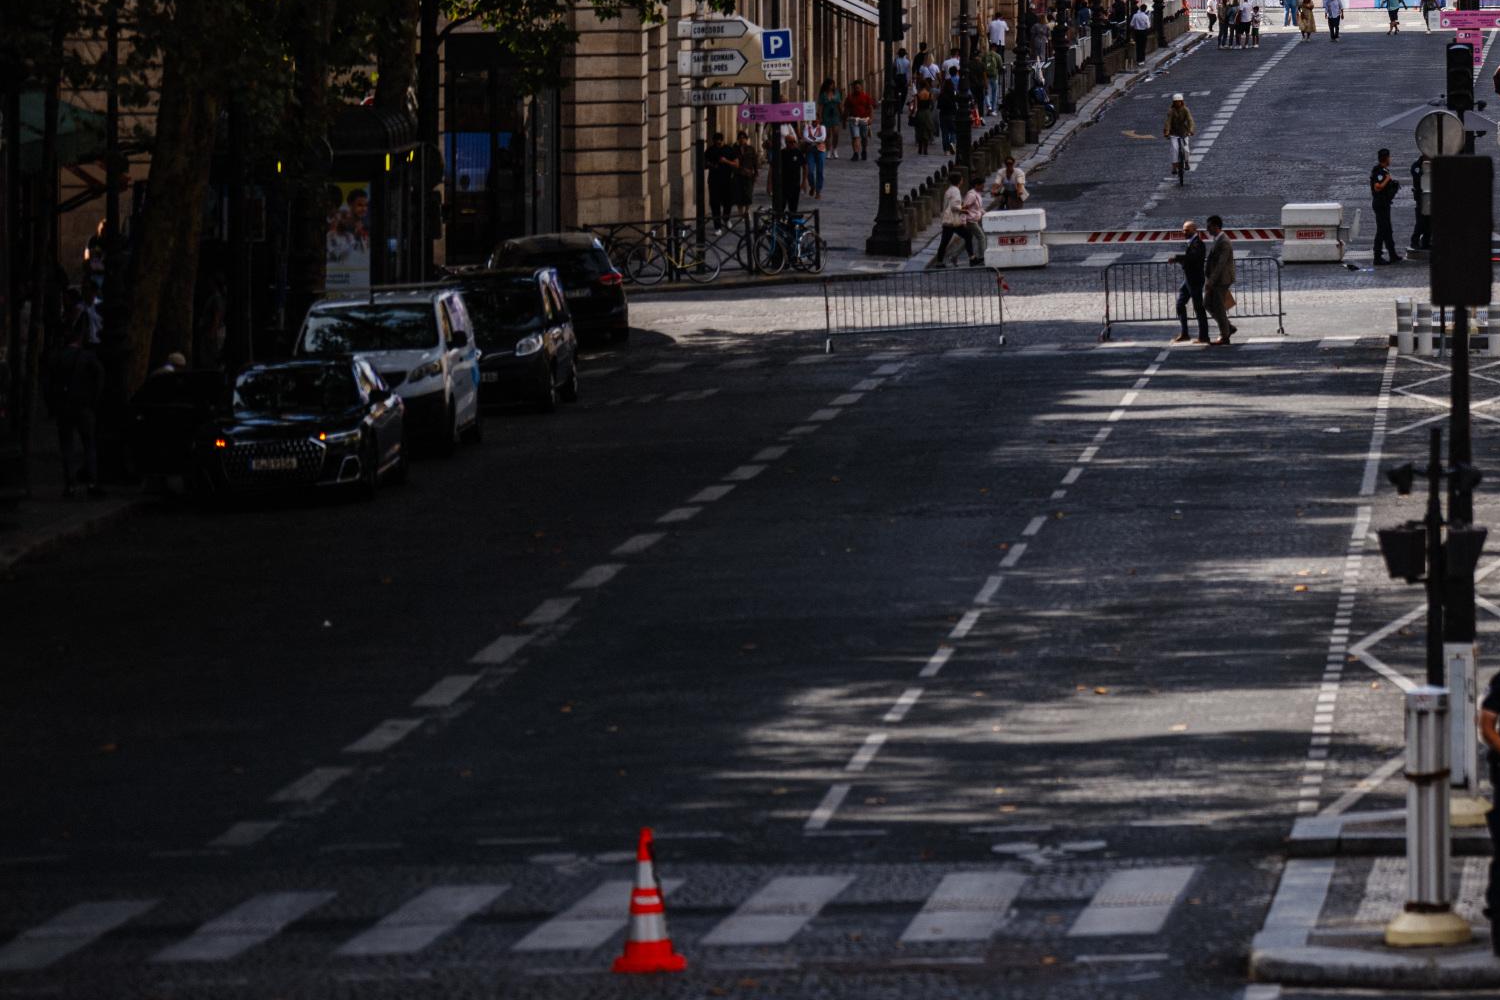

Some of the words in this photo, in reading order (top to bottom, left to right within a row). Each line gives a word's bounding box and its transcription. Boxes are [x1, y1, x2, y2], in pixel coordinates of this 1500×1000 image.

[693, 25, 725, 34] CONCORDE
[769, 35, 783, 54] P
[693, 92, 727, 102] CHÂTELET
